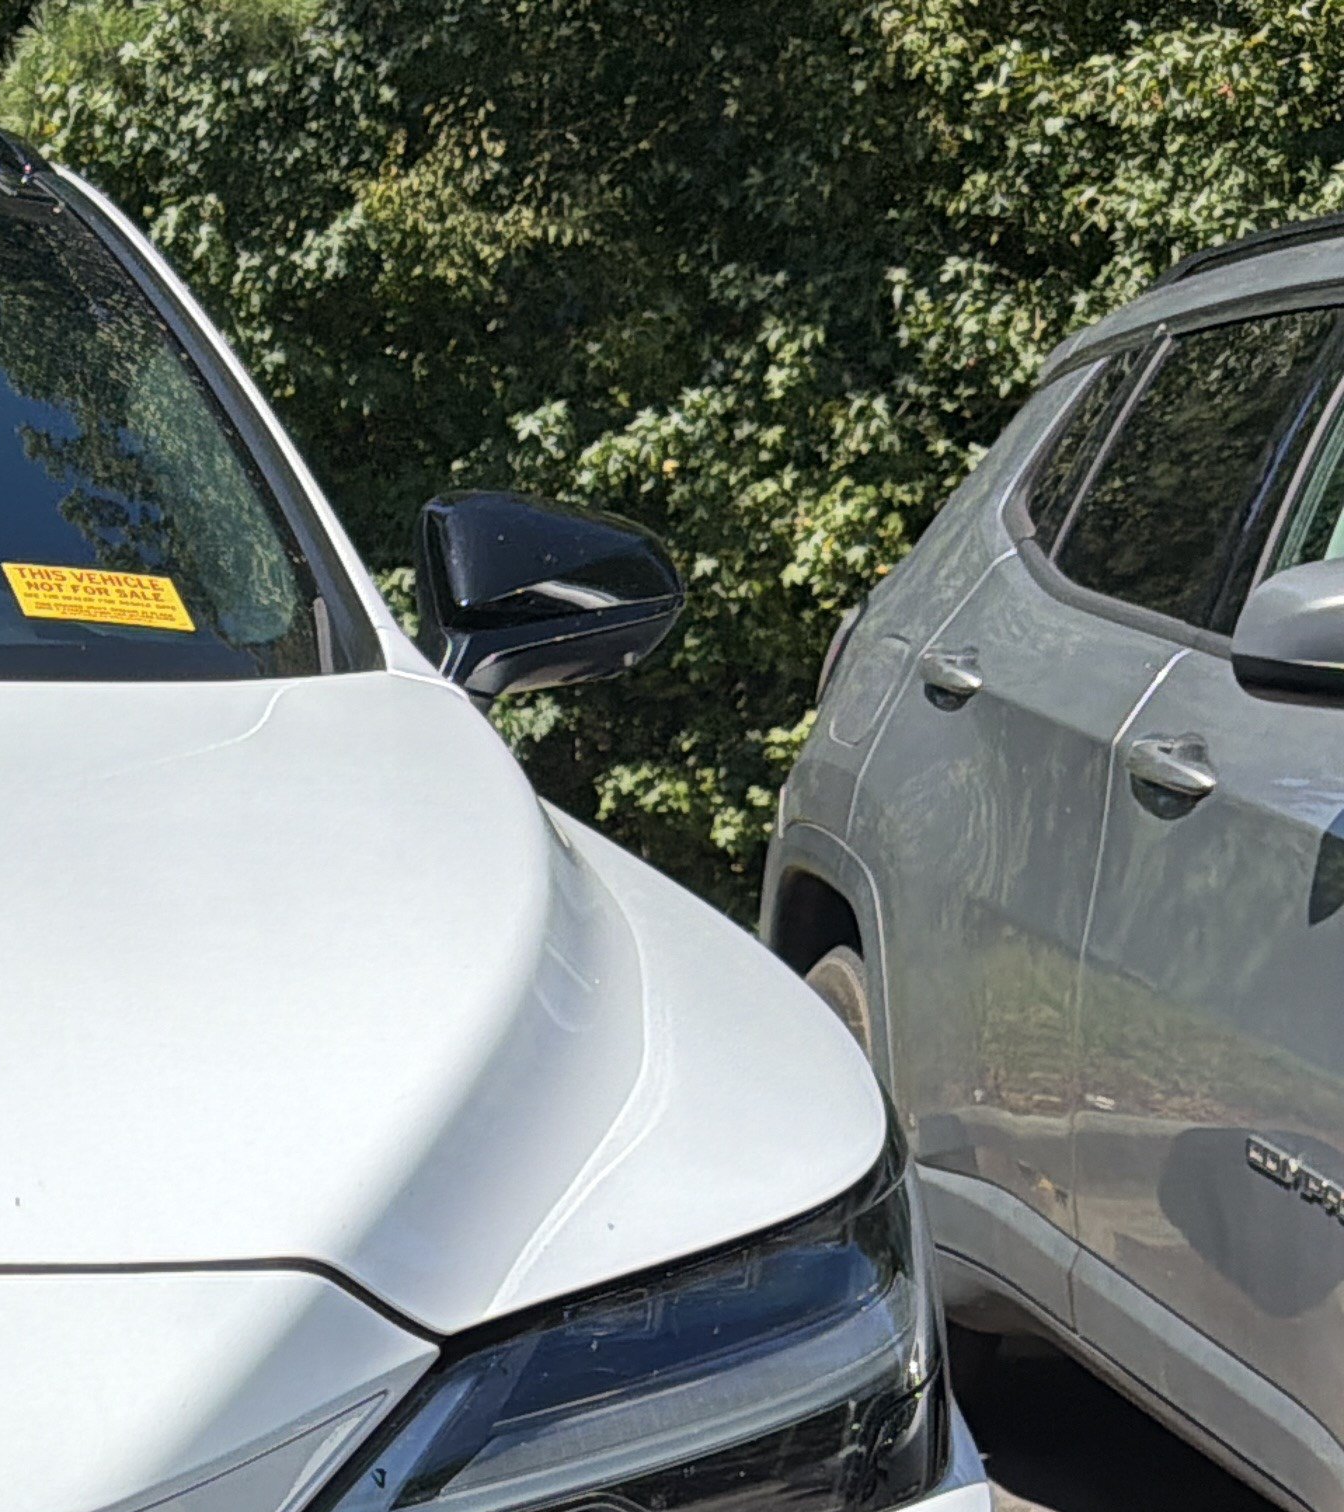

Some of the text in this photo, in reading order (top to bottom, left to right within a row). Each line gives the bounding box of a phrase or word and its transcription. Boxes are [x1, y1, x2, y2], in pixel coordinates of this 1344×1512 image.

[13, 566, 165, 592] THIS VEHICLE
[25, 581, 63, 593] NOT
[70, 584, 110, 596] FOR
[115, 588, 165, 603] SALE
